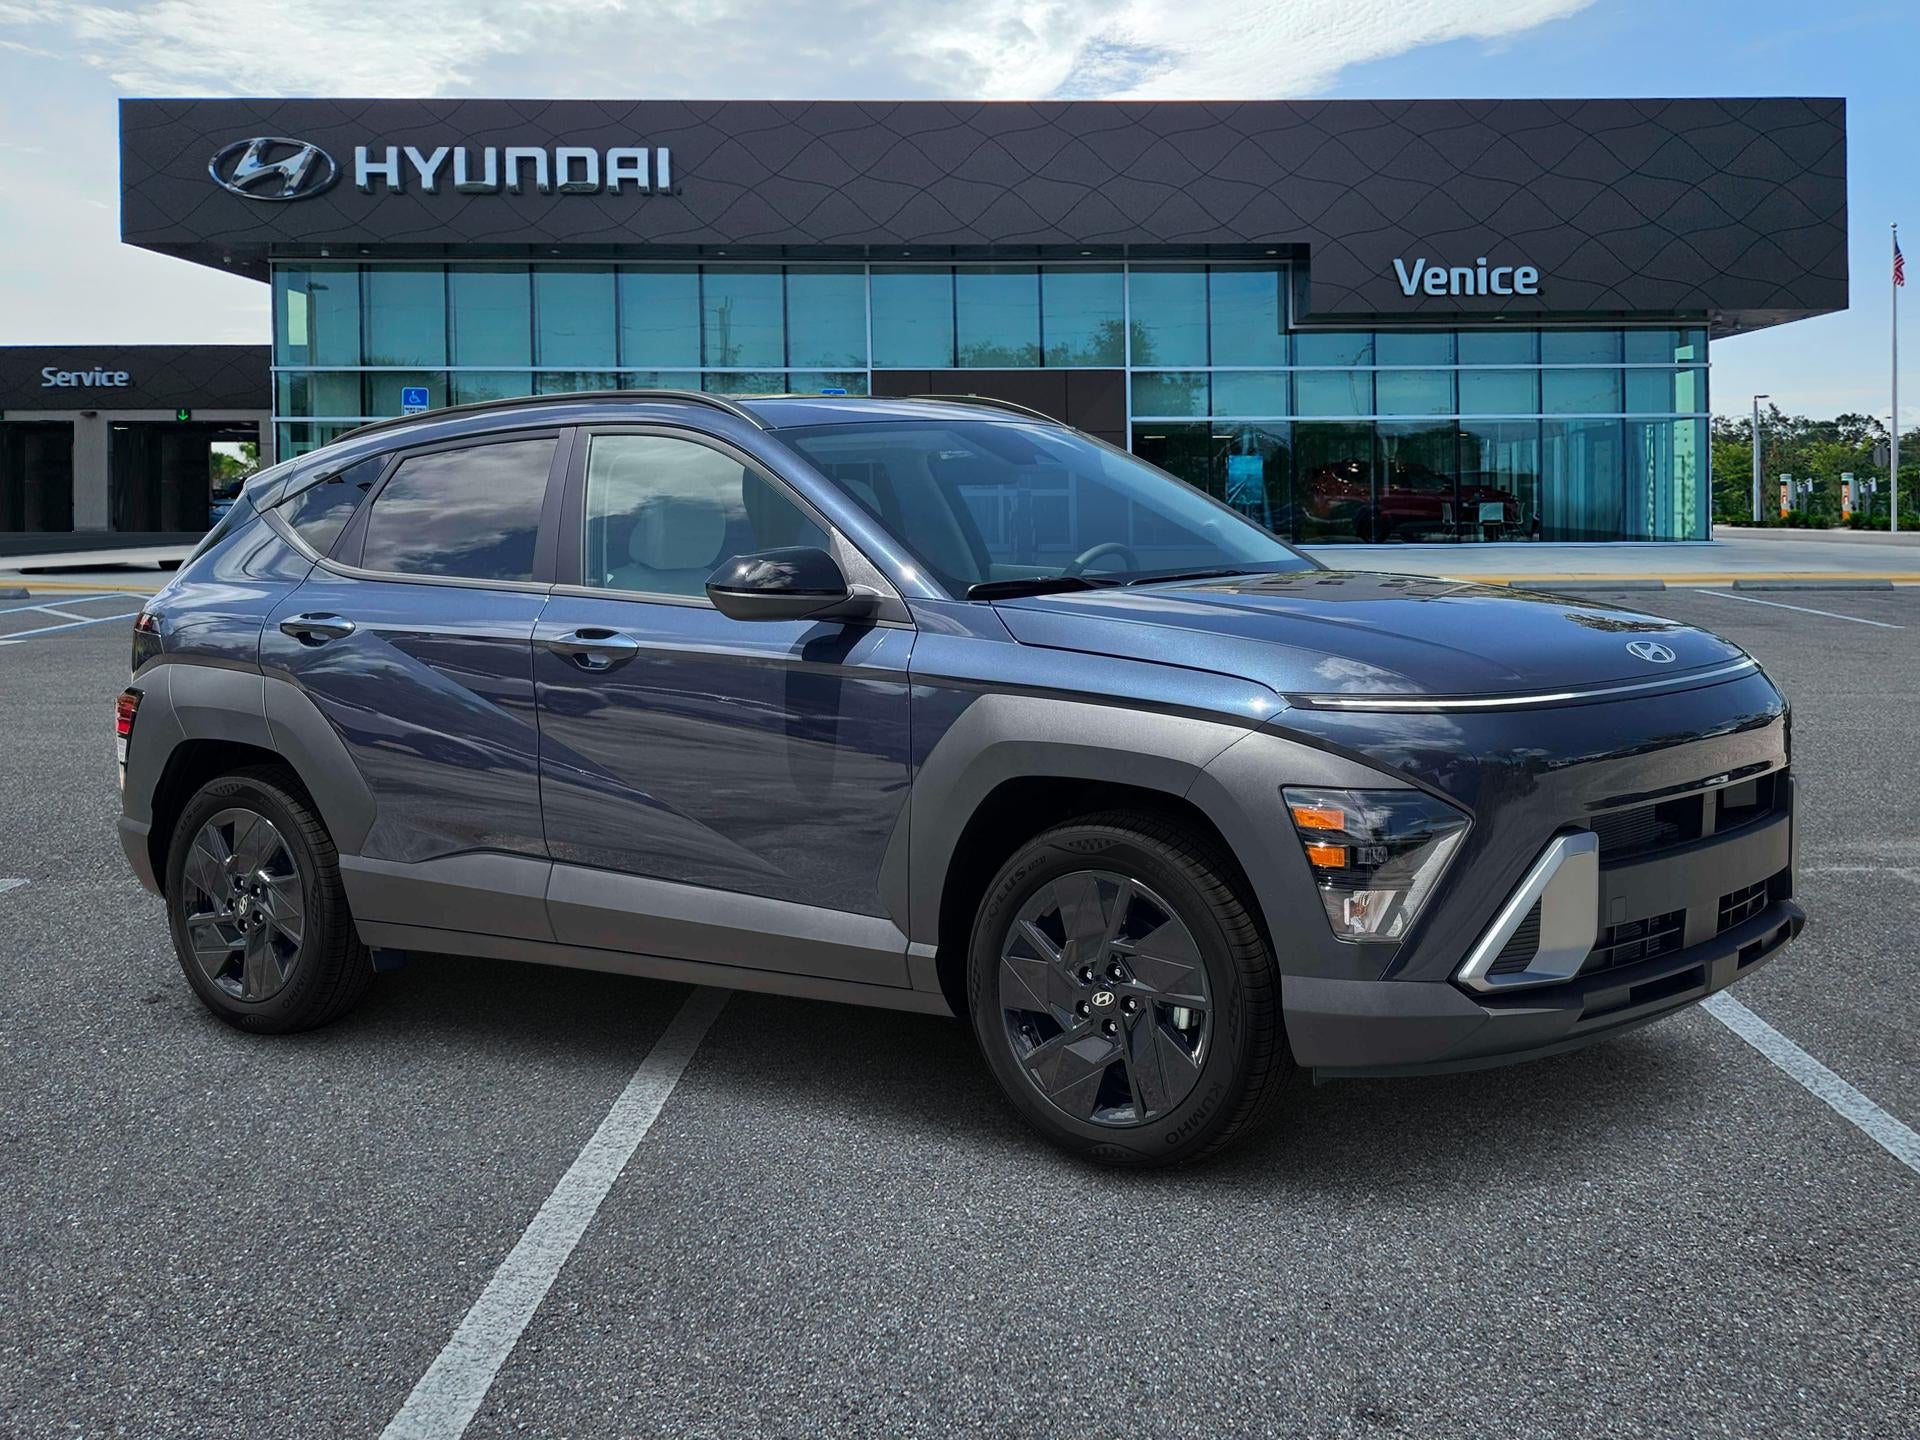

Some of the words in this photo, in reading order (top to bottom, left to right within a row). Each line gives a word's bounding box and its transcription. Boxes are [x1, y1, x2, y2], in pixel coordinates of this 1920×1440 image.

[354, 146, 672, 194] HYUNDAI
[1392, 257, 1539, 296] Venice
[41, 366, 129, 387] Service
[1165, 1081, 1224, 1145] KUMHO
